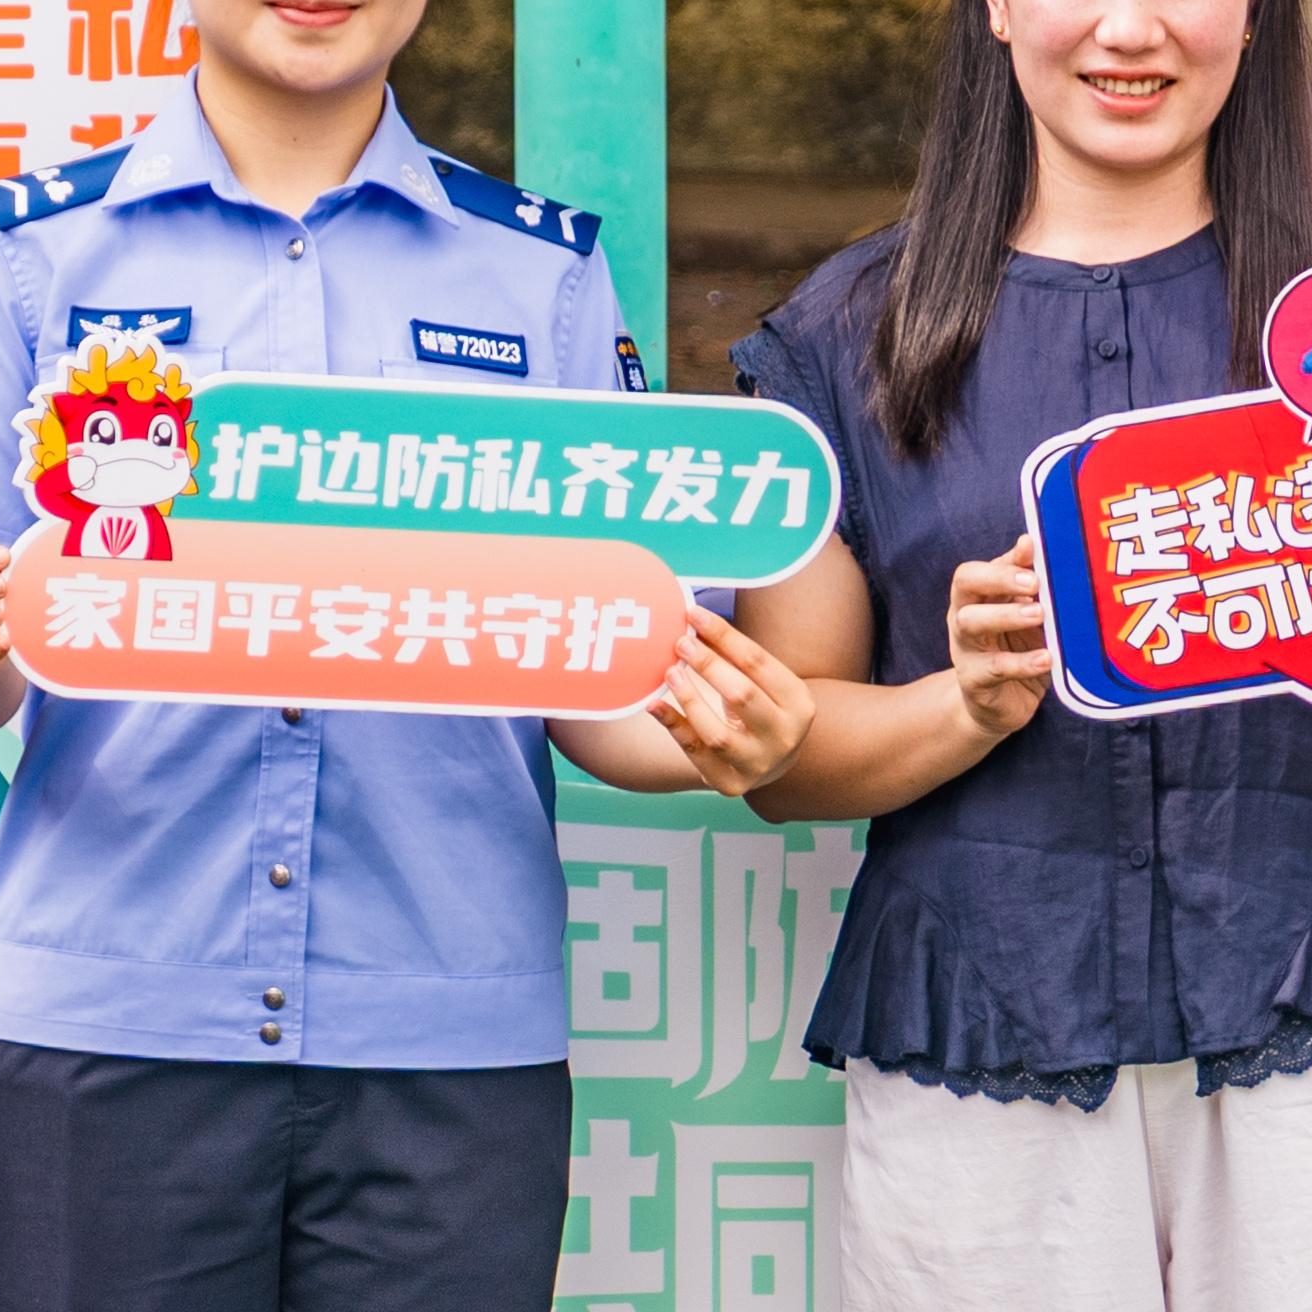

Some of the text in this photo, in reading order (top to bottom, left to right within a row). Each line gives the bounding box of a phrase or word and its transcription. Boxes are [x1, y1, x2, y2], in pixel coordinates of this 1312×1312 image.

[208, 422, 811, 529] 护边防私齐发力
[44, 572, 651, 672] 家国平安共守护
